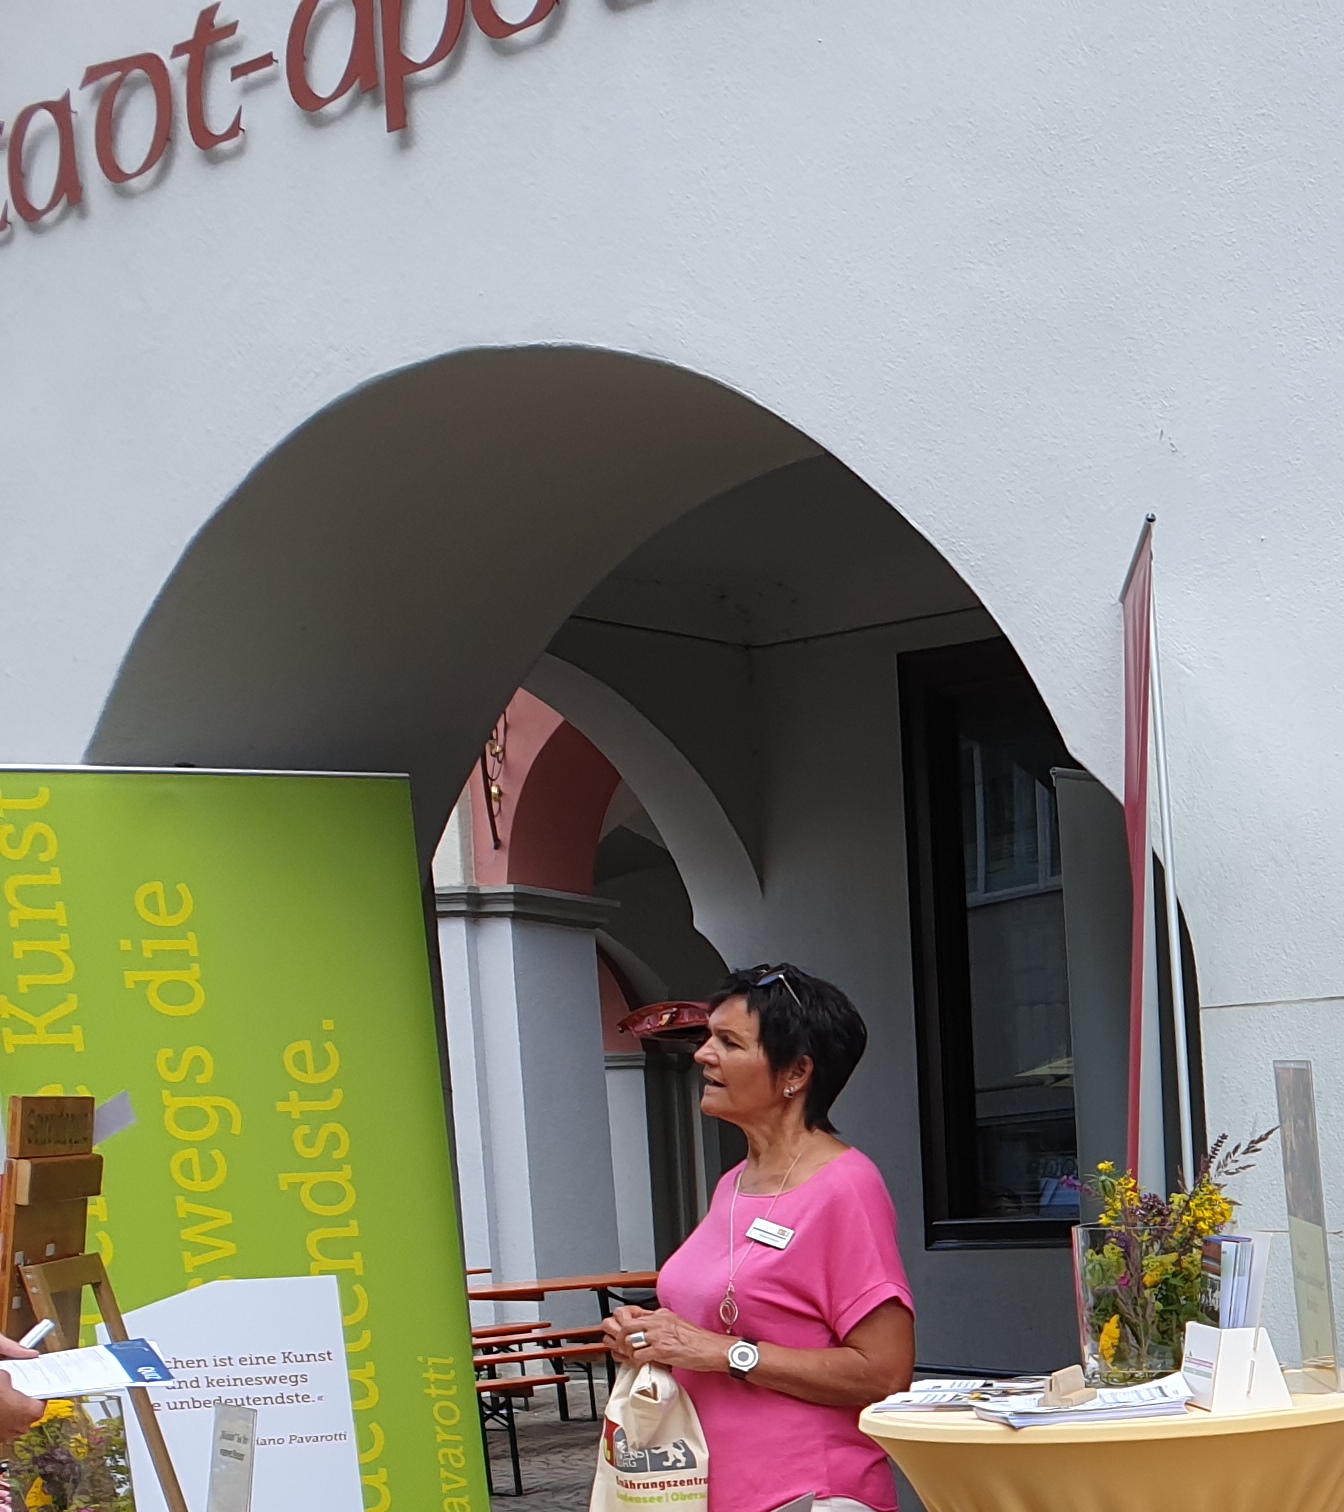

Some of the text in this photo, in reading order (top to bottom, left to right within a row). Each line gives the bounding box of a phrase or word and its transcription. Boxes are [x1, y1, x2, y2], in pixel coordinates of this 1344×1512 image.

[0, 0, 562, 230] adt-ap
[119, 880, 206, 1017] die
[165, 1350, 334, 1370] chen ist eine Kunst
[205, 1372, 309, 1389] keineswegs
[288, 1431, 347, 1445] Pavarotti
